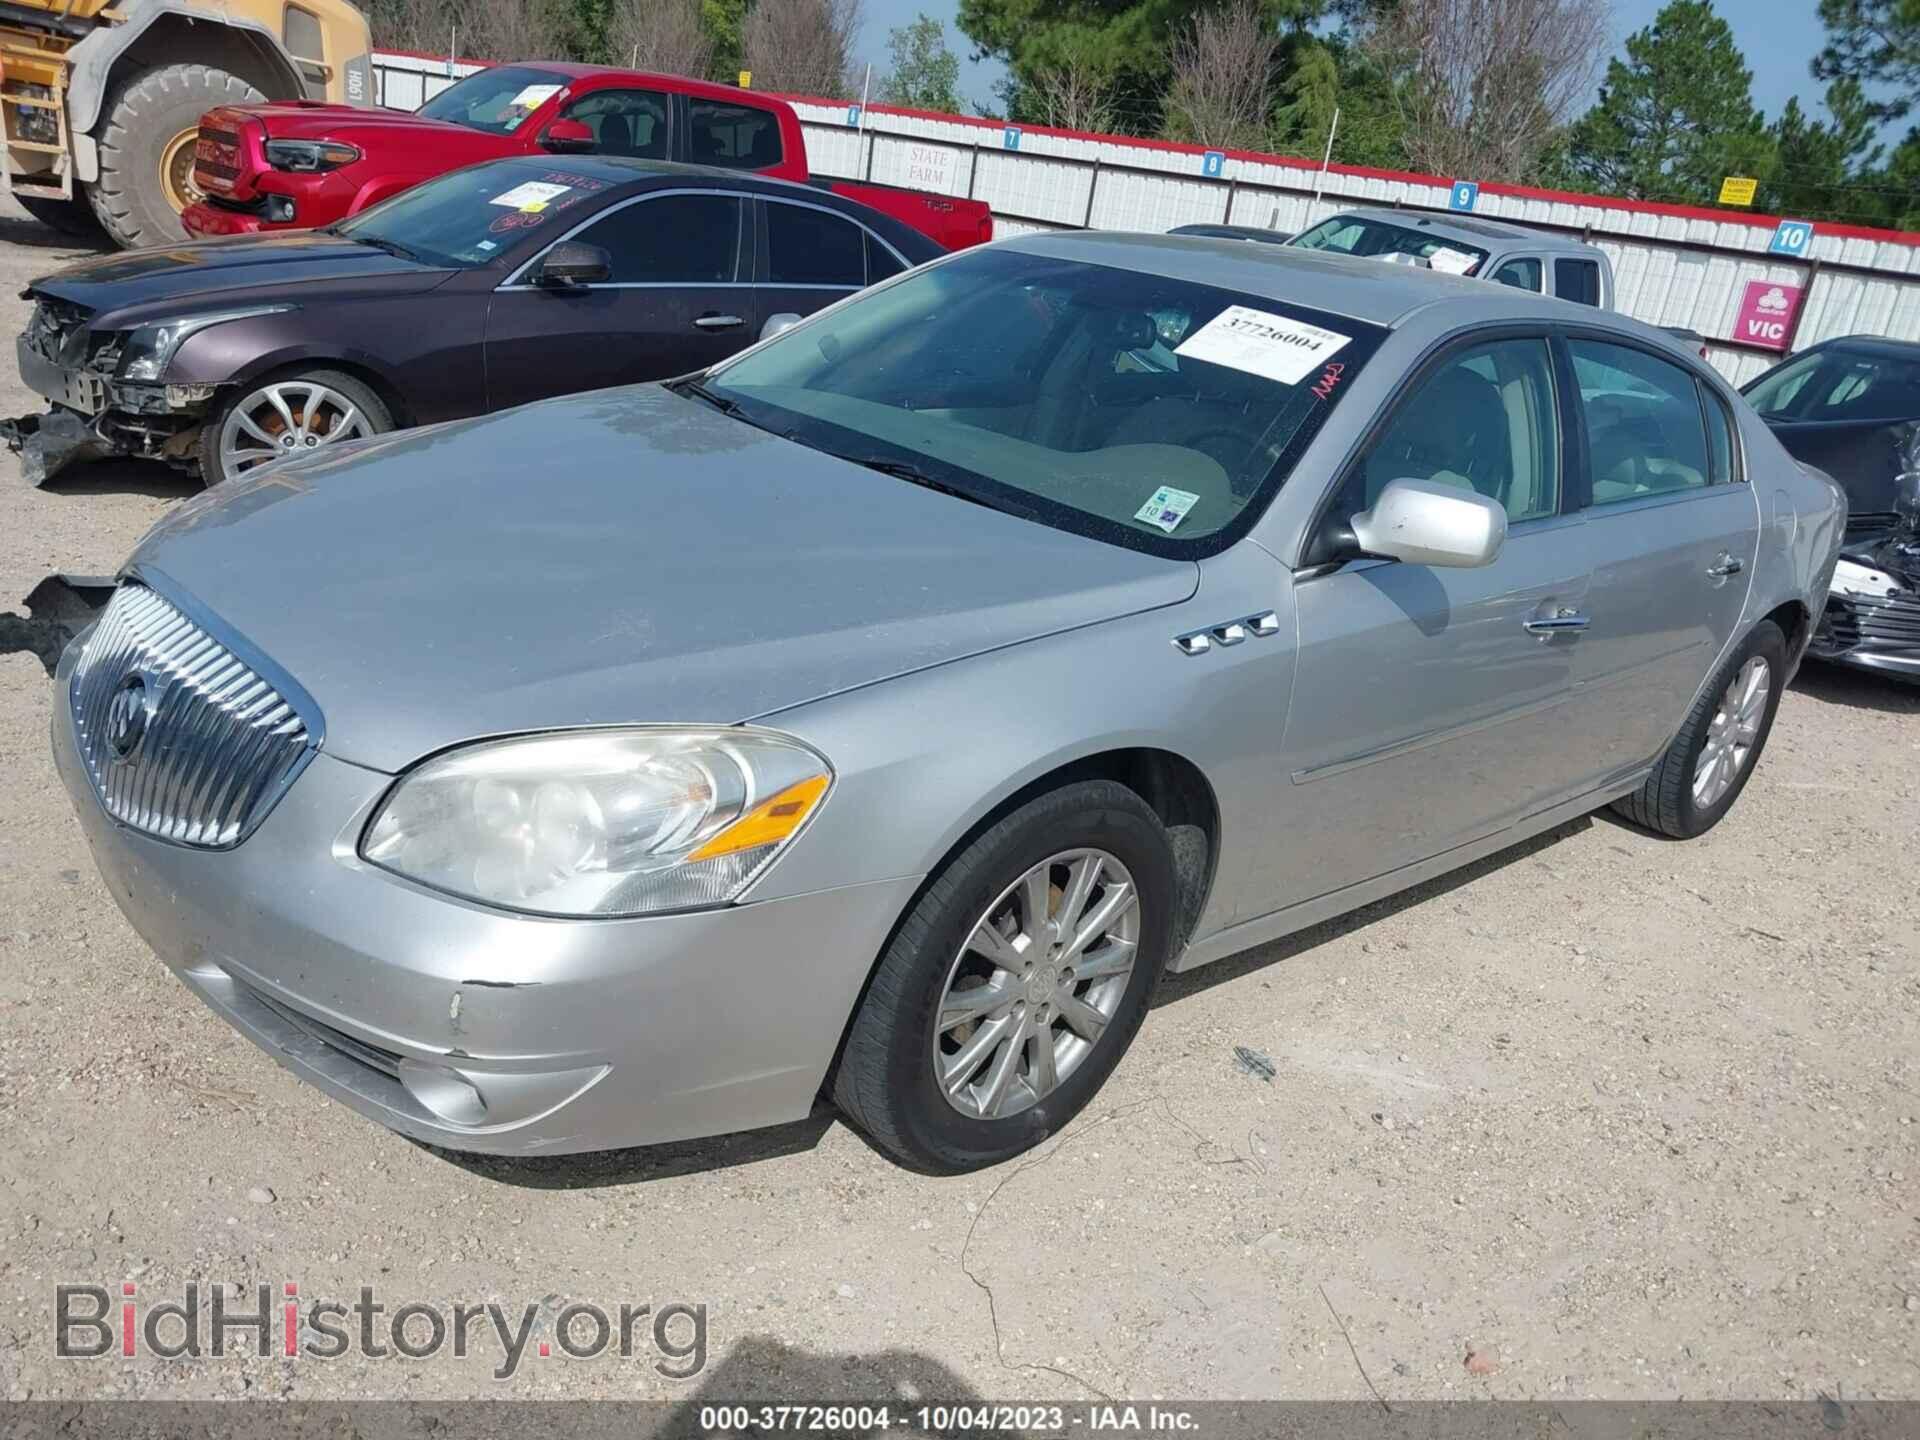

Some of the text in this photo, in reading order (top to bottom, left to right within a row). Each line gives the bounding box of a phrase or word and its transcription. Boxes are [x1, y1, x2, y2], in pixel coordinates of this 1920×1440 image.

[1010, 131, 1016, 145] 7
[911, 146, 949, 167] STATE
[1209, 156, 1218, 173] 8
[909, 165, 944, 185] FARM
[1459, 187, 1470, 206] 9
[1780, 227, 1804, 248] 10
[1222, 317, 1323, 352] 37726004
[1748, 319, 1785, 340] VIC
